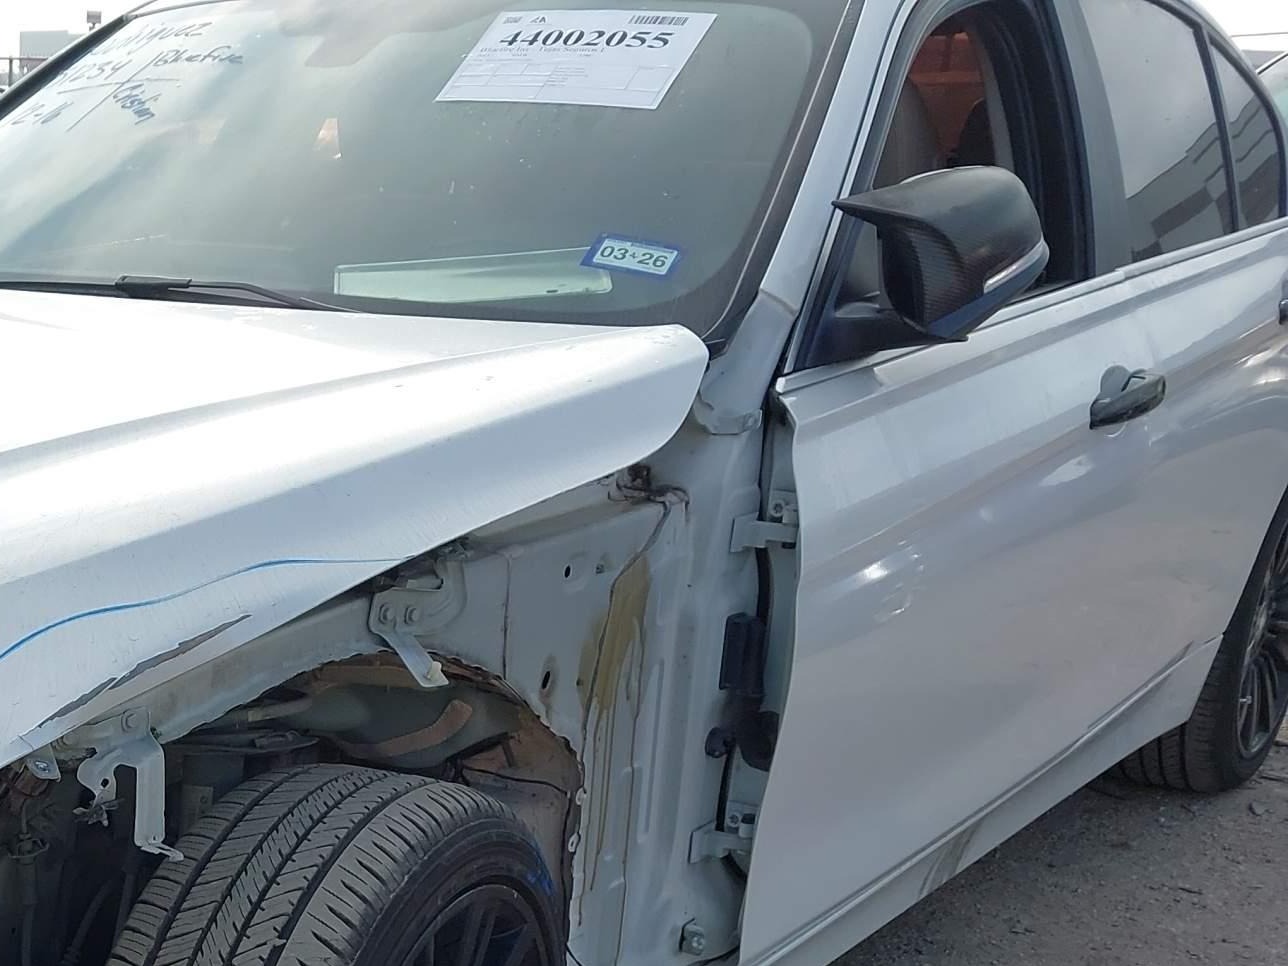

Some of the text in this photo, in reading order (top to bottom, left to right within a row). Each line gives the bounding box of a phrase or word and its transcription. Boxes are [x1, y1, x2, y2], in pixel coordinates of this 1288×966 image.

[499, 29, 675, 49] 44002055
[600, 246, 669, 268] 03 26
